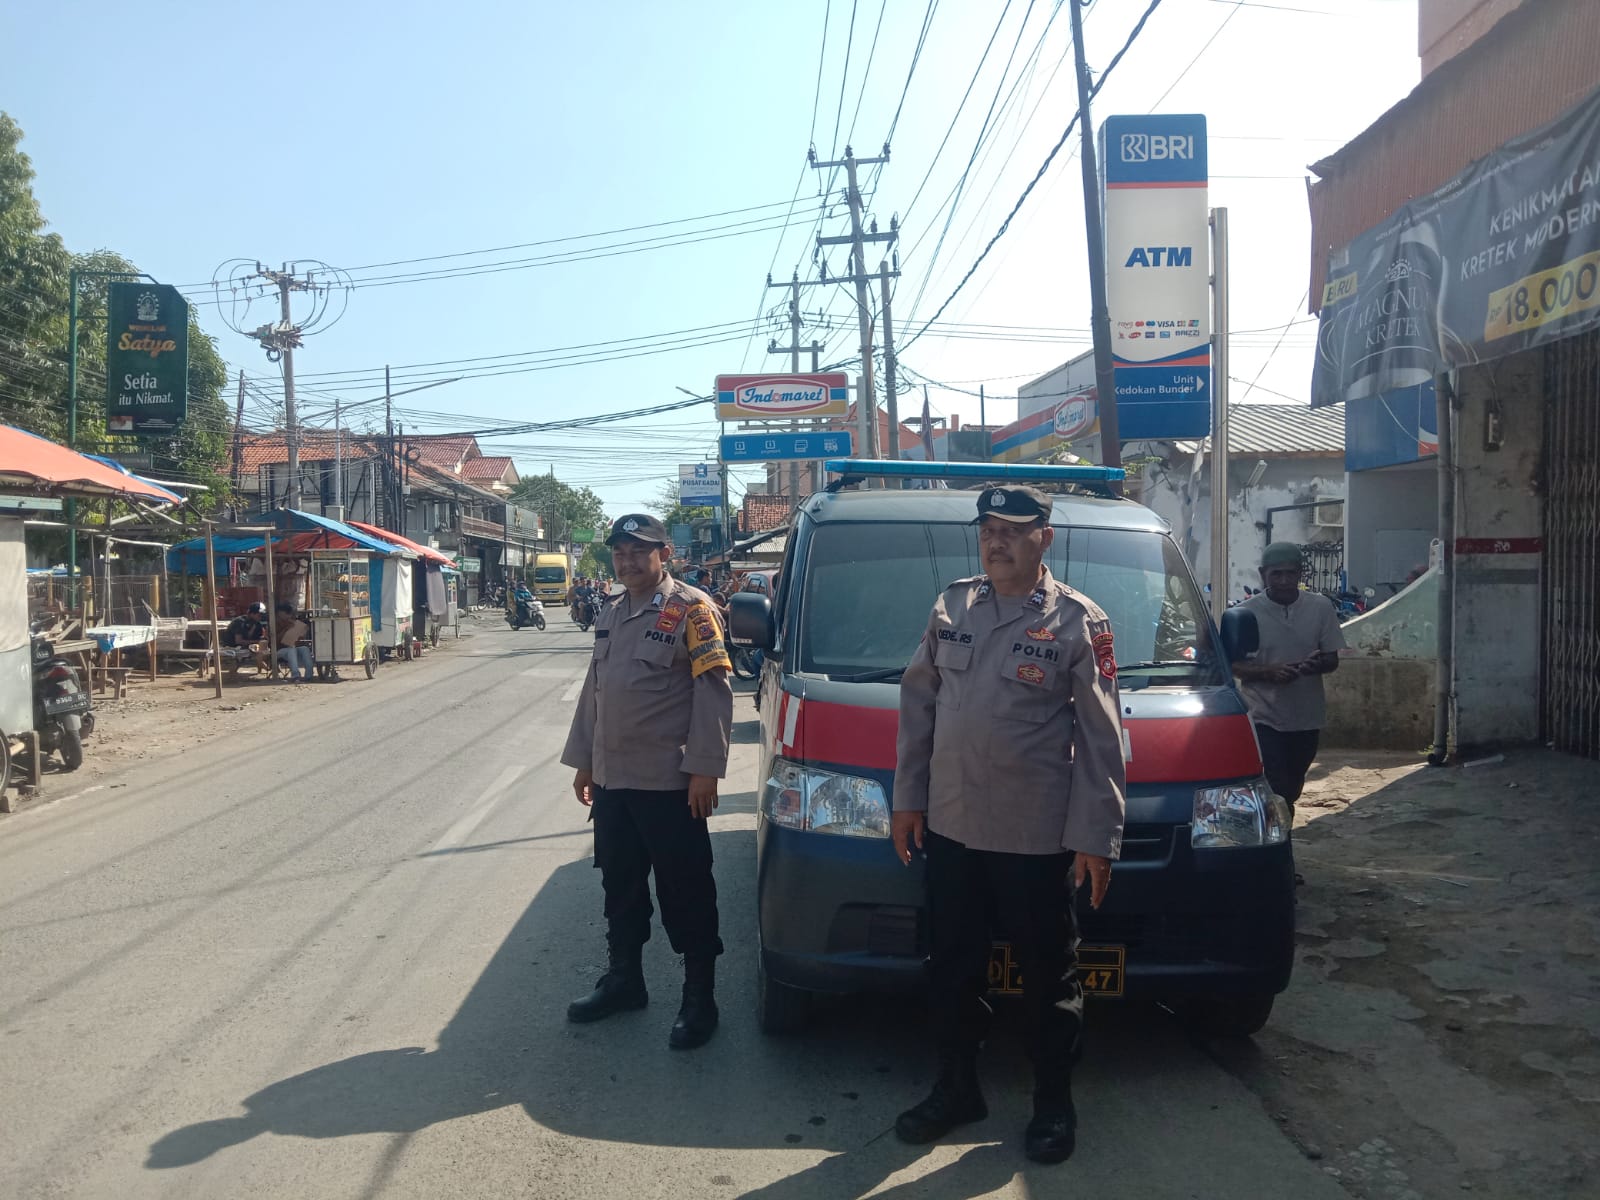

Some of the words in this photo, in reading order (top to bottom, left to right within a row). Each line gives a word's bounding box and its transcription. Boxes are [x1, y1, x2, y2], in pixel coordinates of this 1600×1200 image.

[1150, 136, 1194, 159] BRI
[1124, 247, 1192, 267] ATM
[1461, 237, 1518, 281] KRETEK
[1326, 280, 1352, 302] BRU
[1355, 287, 1426, 334] MAGNU
[118, 332, 176, 358] Satya
[124, 372, 158, 390] Setia
[1158, 385, 1194, 394] Bunder
[1173, 375, 1194, 384] Unit
[118, 394, 132, 406] itu
[741, 387, 823, 404] Indomaret
[644, 630, 676, 646] POLRI
[1012, 642, 1059, 662] POLRI
